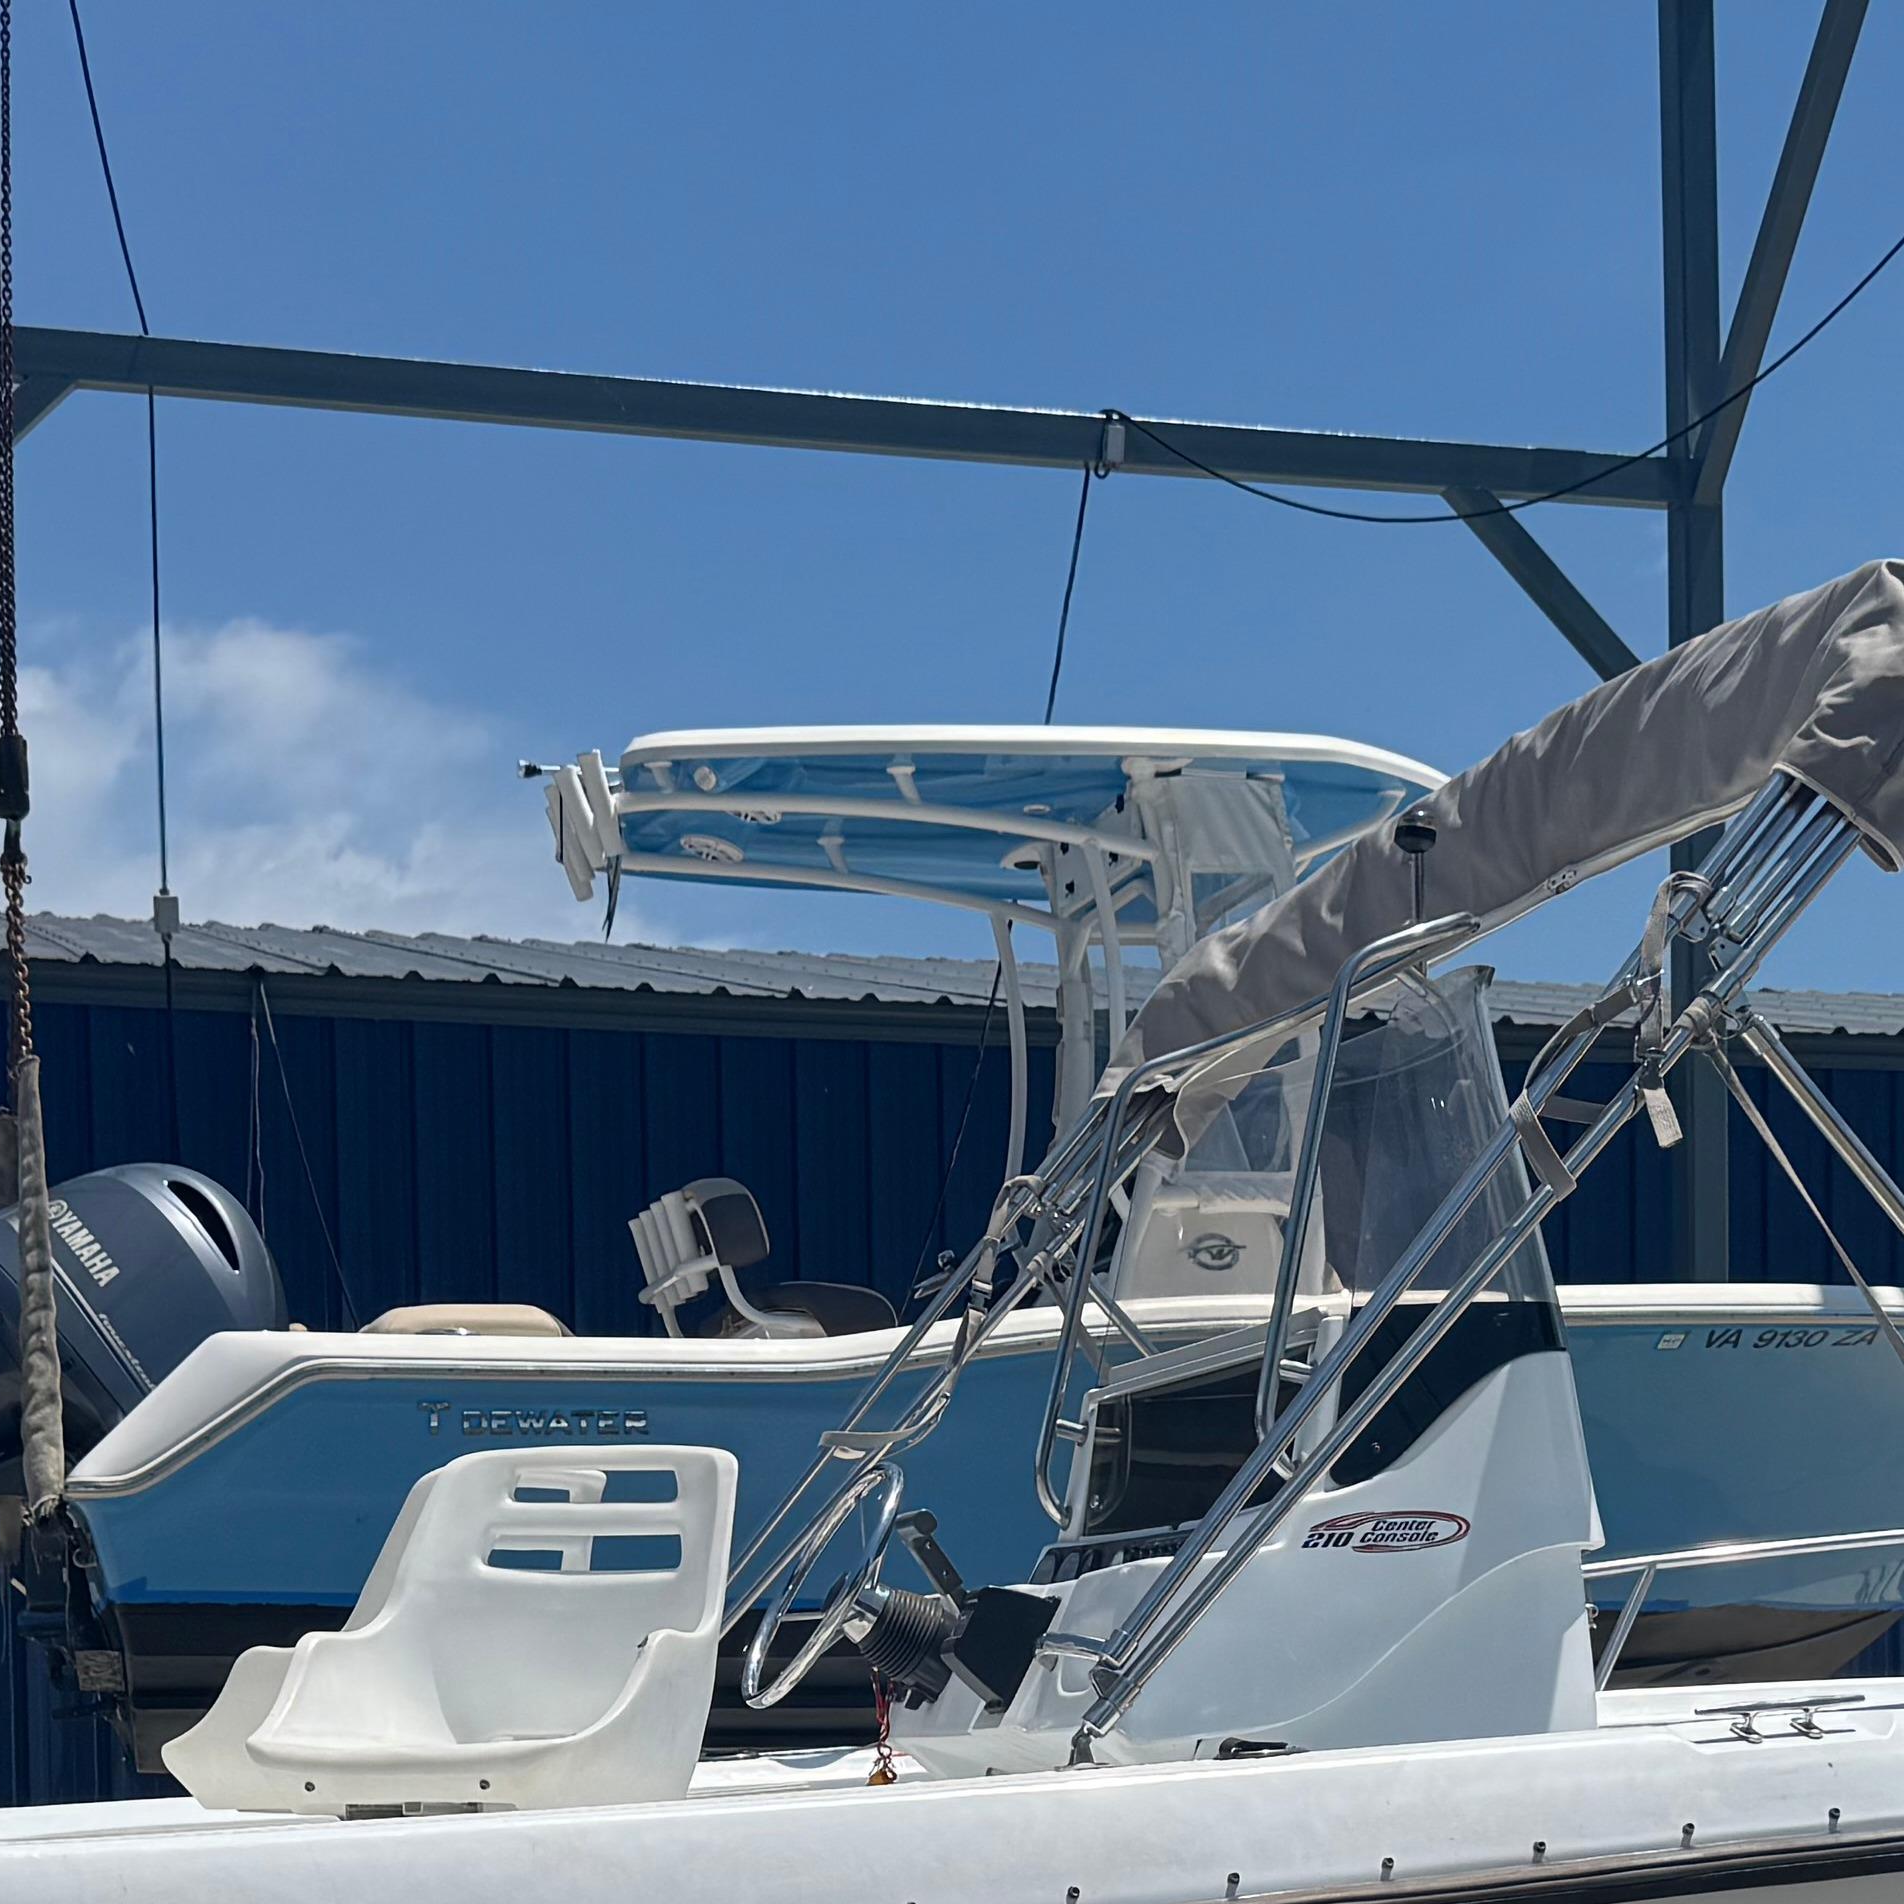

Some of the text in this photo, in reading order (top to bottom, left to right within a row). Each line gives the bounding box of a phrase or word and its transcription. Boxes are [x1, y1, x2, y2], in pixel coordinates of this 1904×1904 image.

[52, 1211, 120, 1287] YAMAHA
[1704, 1328, 1743, 1349] VA
[1752, 1329, 1829, 1349] 9130
[1832, 1327, 1879, 1347] ZA
[1370, 1519, 1437, 1532] Center
[1301, 1531, 1355, 1549] 210
